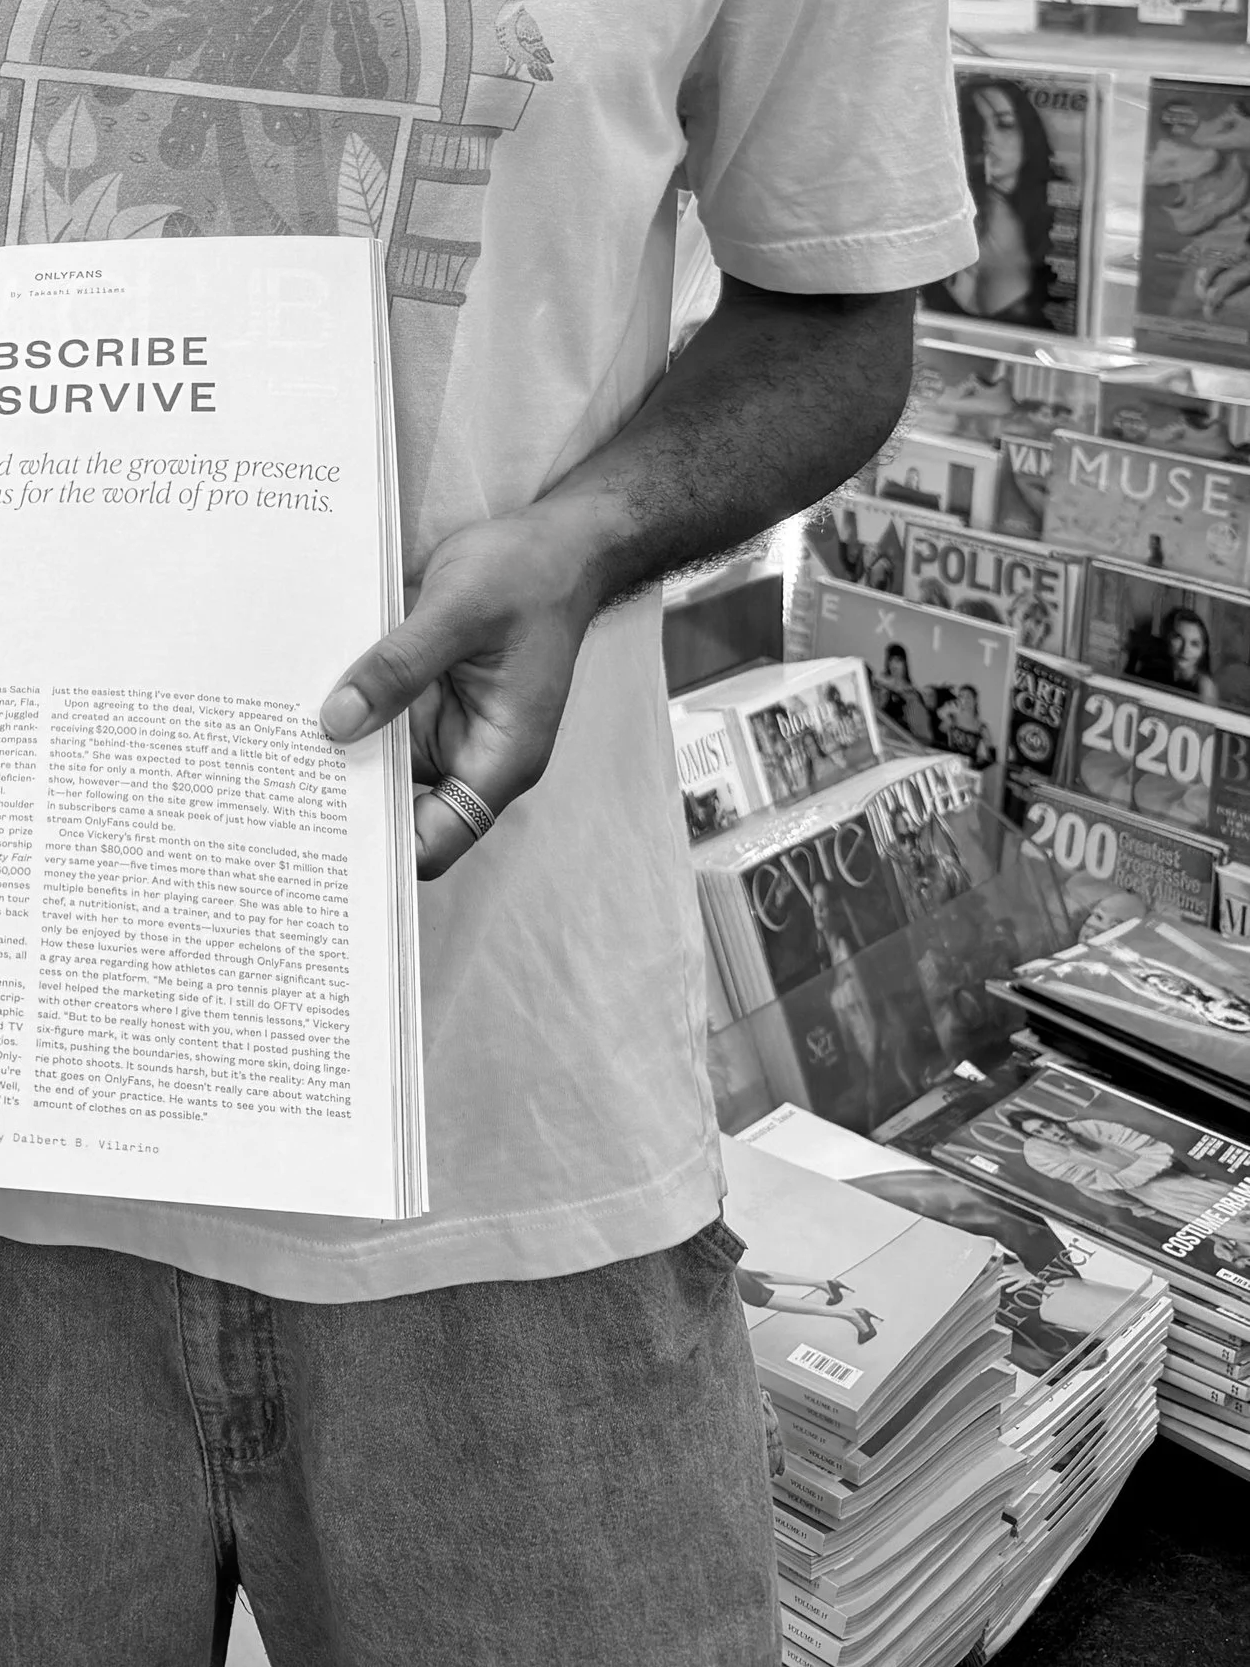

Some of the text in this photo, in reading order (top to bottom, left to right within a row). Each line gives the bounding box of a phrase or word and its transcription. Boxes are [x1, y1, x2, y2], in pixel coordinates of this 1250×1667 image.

[34, 269, 103, 282] ONLYFANS
[19, 452, 79, 476] what
[86, 451, 122, 475] the
[126, 453, 230, 482] growing
[234, 459, 341, 483] presence
[1067, 445, 1236, 518] MUSE
[14, 480, 53, 511] for
[59, 480, 95, 504] the
[102, 480, 172, 505] world
[179, 480, 205, 512] of
[206, 487, 248, 512] pro
[256, 487, 334, 513] tennis.
[910, 536, 1060, 598] POLICE
[821, 592, 1000, 668] EXIT
[9, 685, 41, 694] Sachia
[1021, 802, 1118, 880] 200
[1116, 851, 1200, 894] Progressive
[1116, 869, 1208, 914] Rock Albums
[13, 1133, 67, 1147] Dalbert
[98, 1140, 160, 1155] Vilarino
[1162, 1208, 1231, 1258] COSTUME
